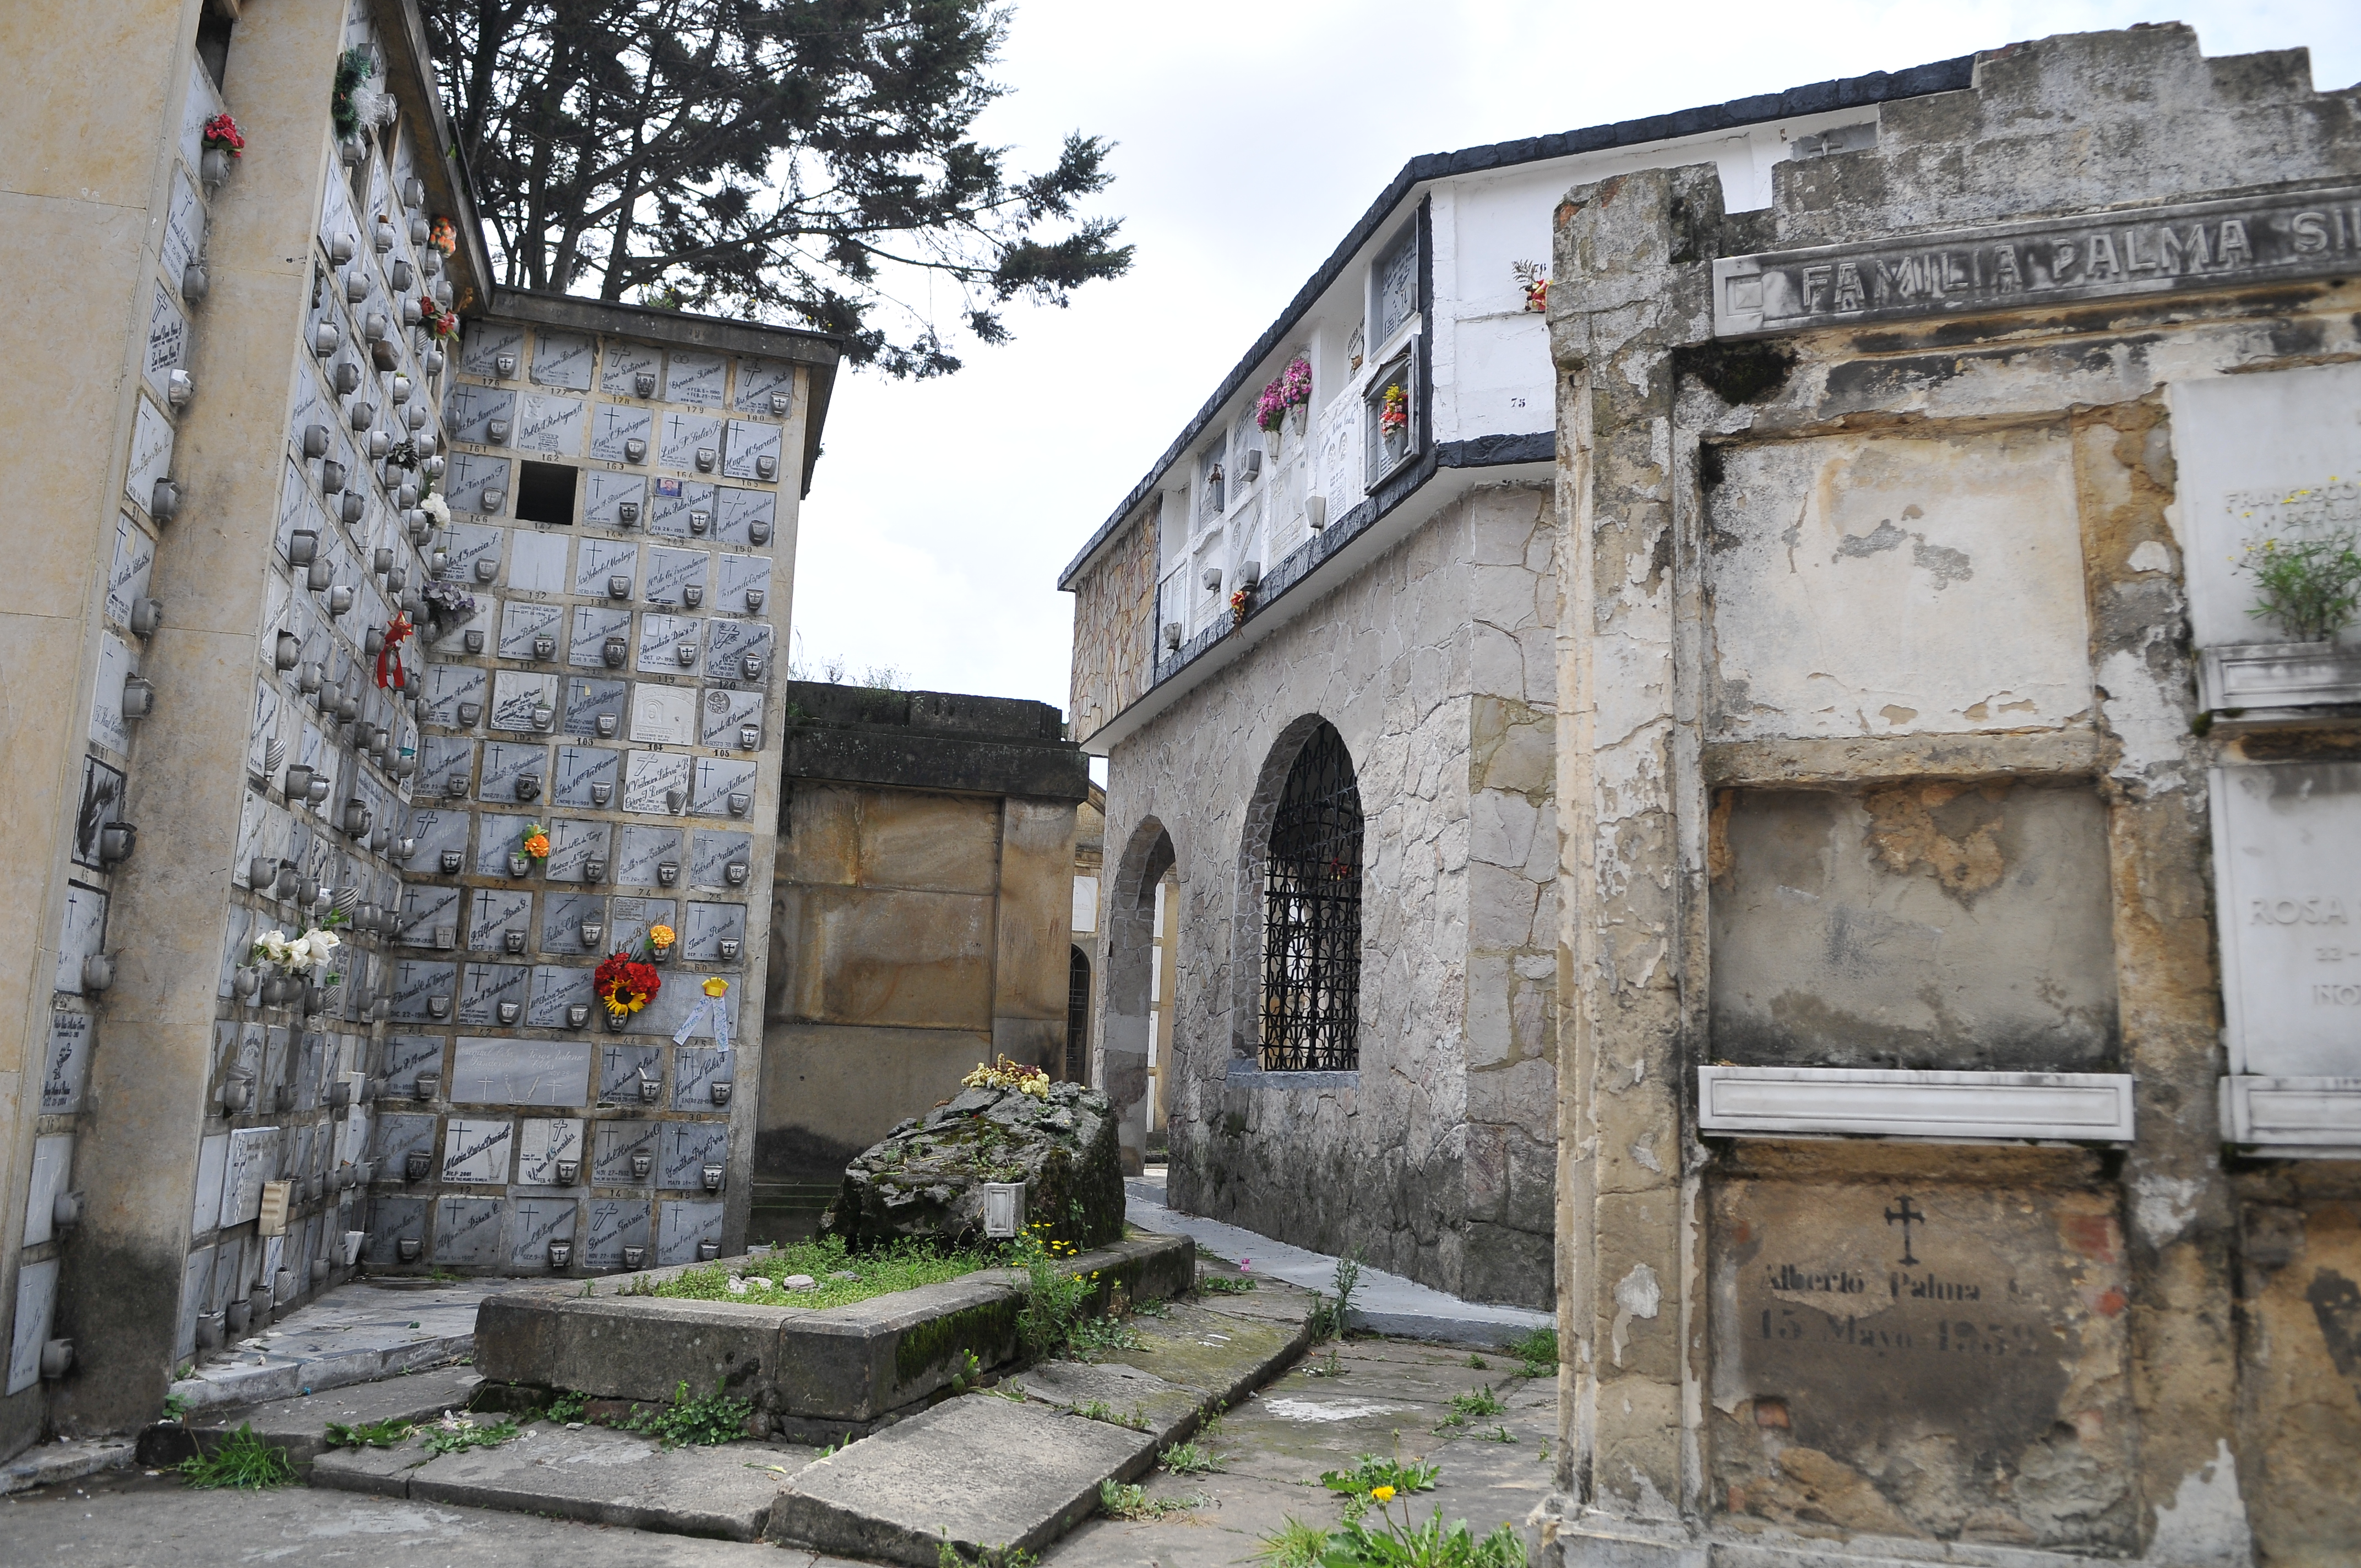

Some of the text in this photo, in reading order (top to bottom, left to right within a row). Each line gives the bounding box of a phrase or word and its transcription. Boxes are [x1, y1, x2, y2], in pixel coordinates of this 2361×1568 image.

[1801, 244, 2022, 308] FAMILIA
[2052, 220, 2253, 279] PALMA
[1511, 398, 1526, 408] 75
[719, 680, 736, 689] 120
[2249, 896, 2348, 926] ROSA
[709, 917, 734, 937] Ricardo
[1764, 1265, 1980, 1301] Alberto Palma
[1762, 1309, 1802, 1340] 15
[1825, 1315, 1912, 1348] Mayo
